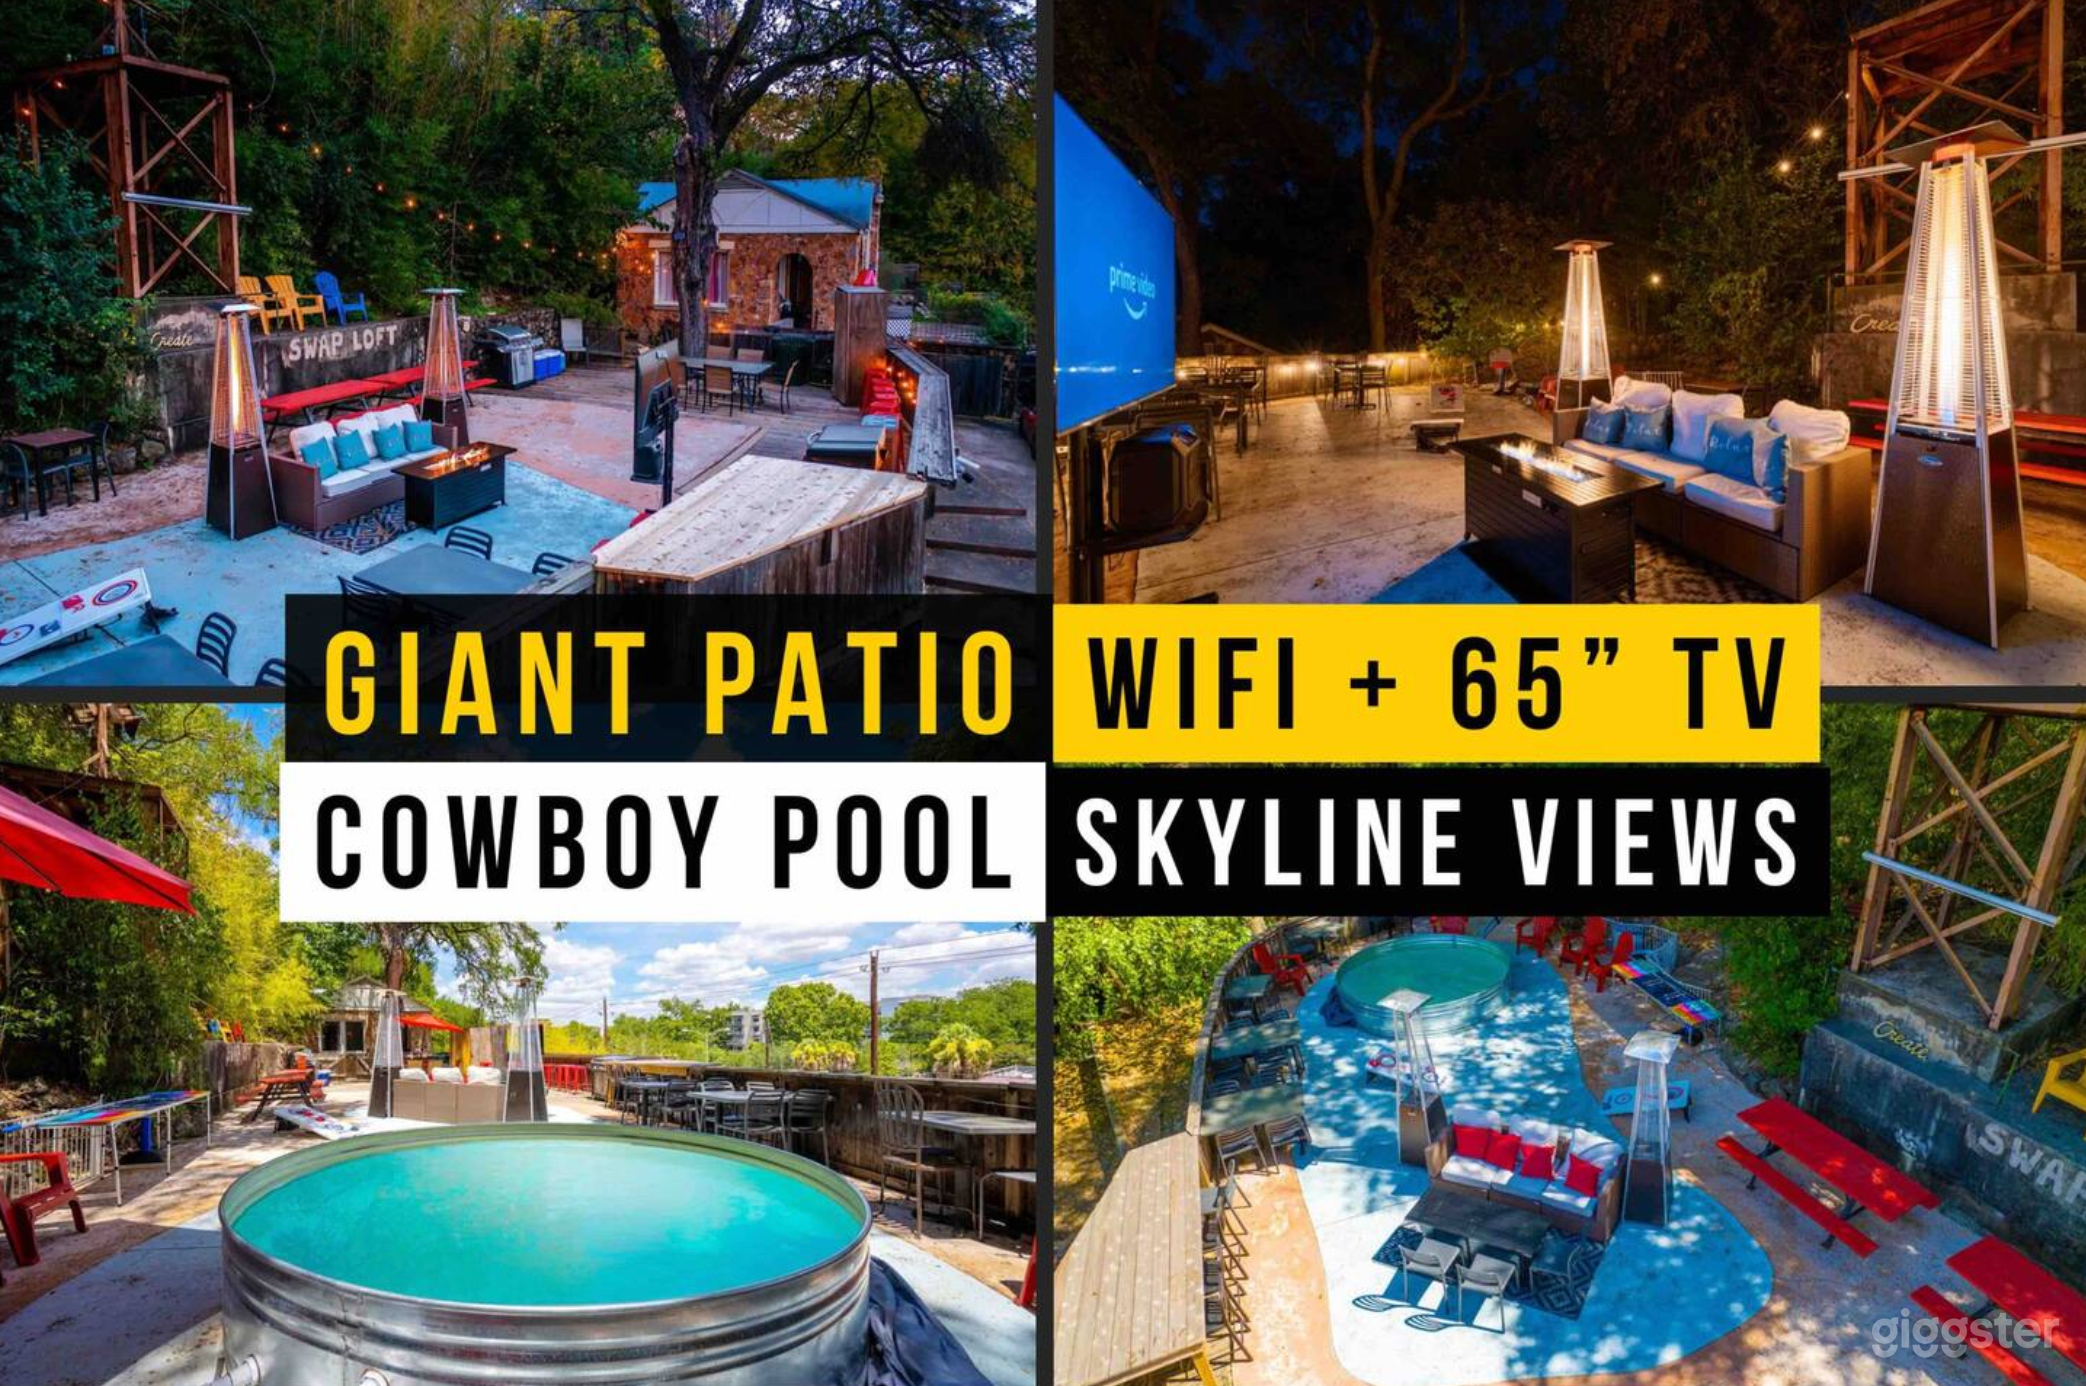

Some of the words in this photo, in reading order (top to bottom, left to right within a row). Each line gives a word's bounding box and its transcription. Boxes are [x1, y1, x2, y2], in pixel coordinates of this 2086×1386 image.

[1109, 262, 1136, 294] prime
[1136, 270, 1156, 300] video
[150, 332, 194, 350] Create
[288, 330, 343, 361] SWAP
[352, 324, 398, 351] LOFT
[1873, 1020, 1929, 1059] Create
